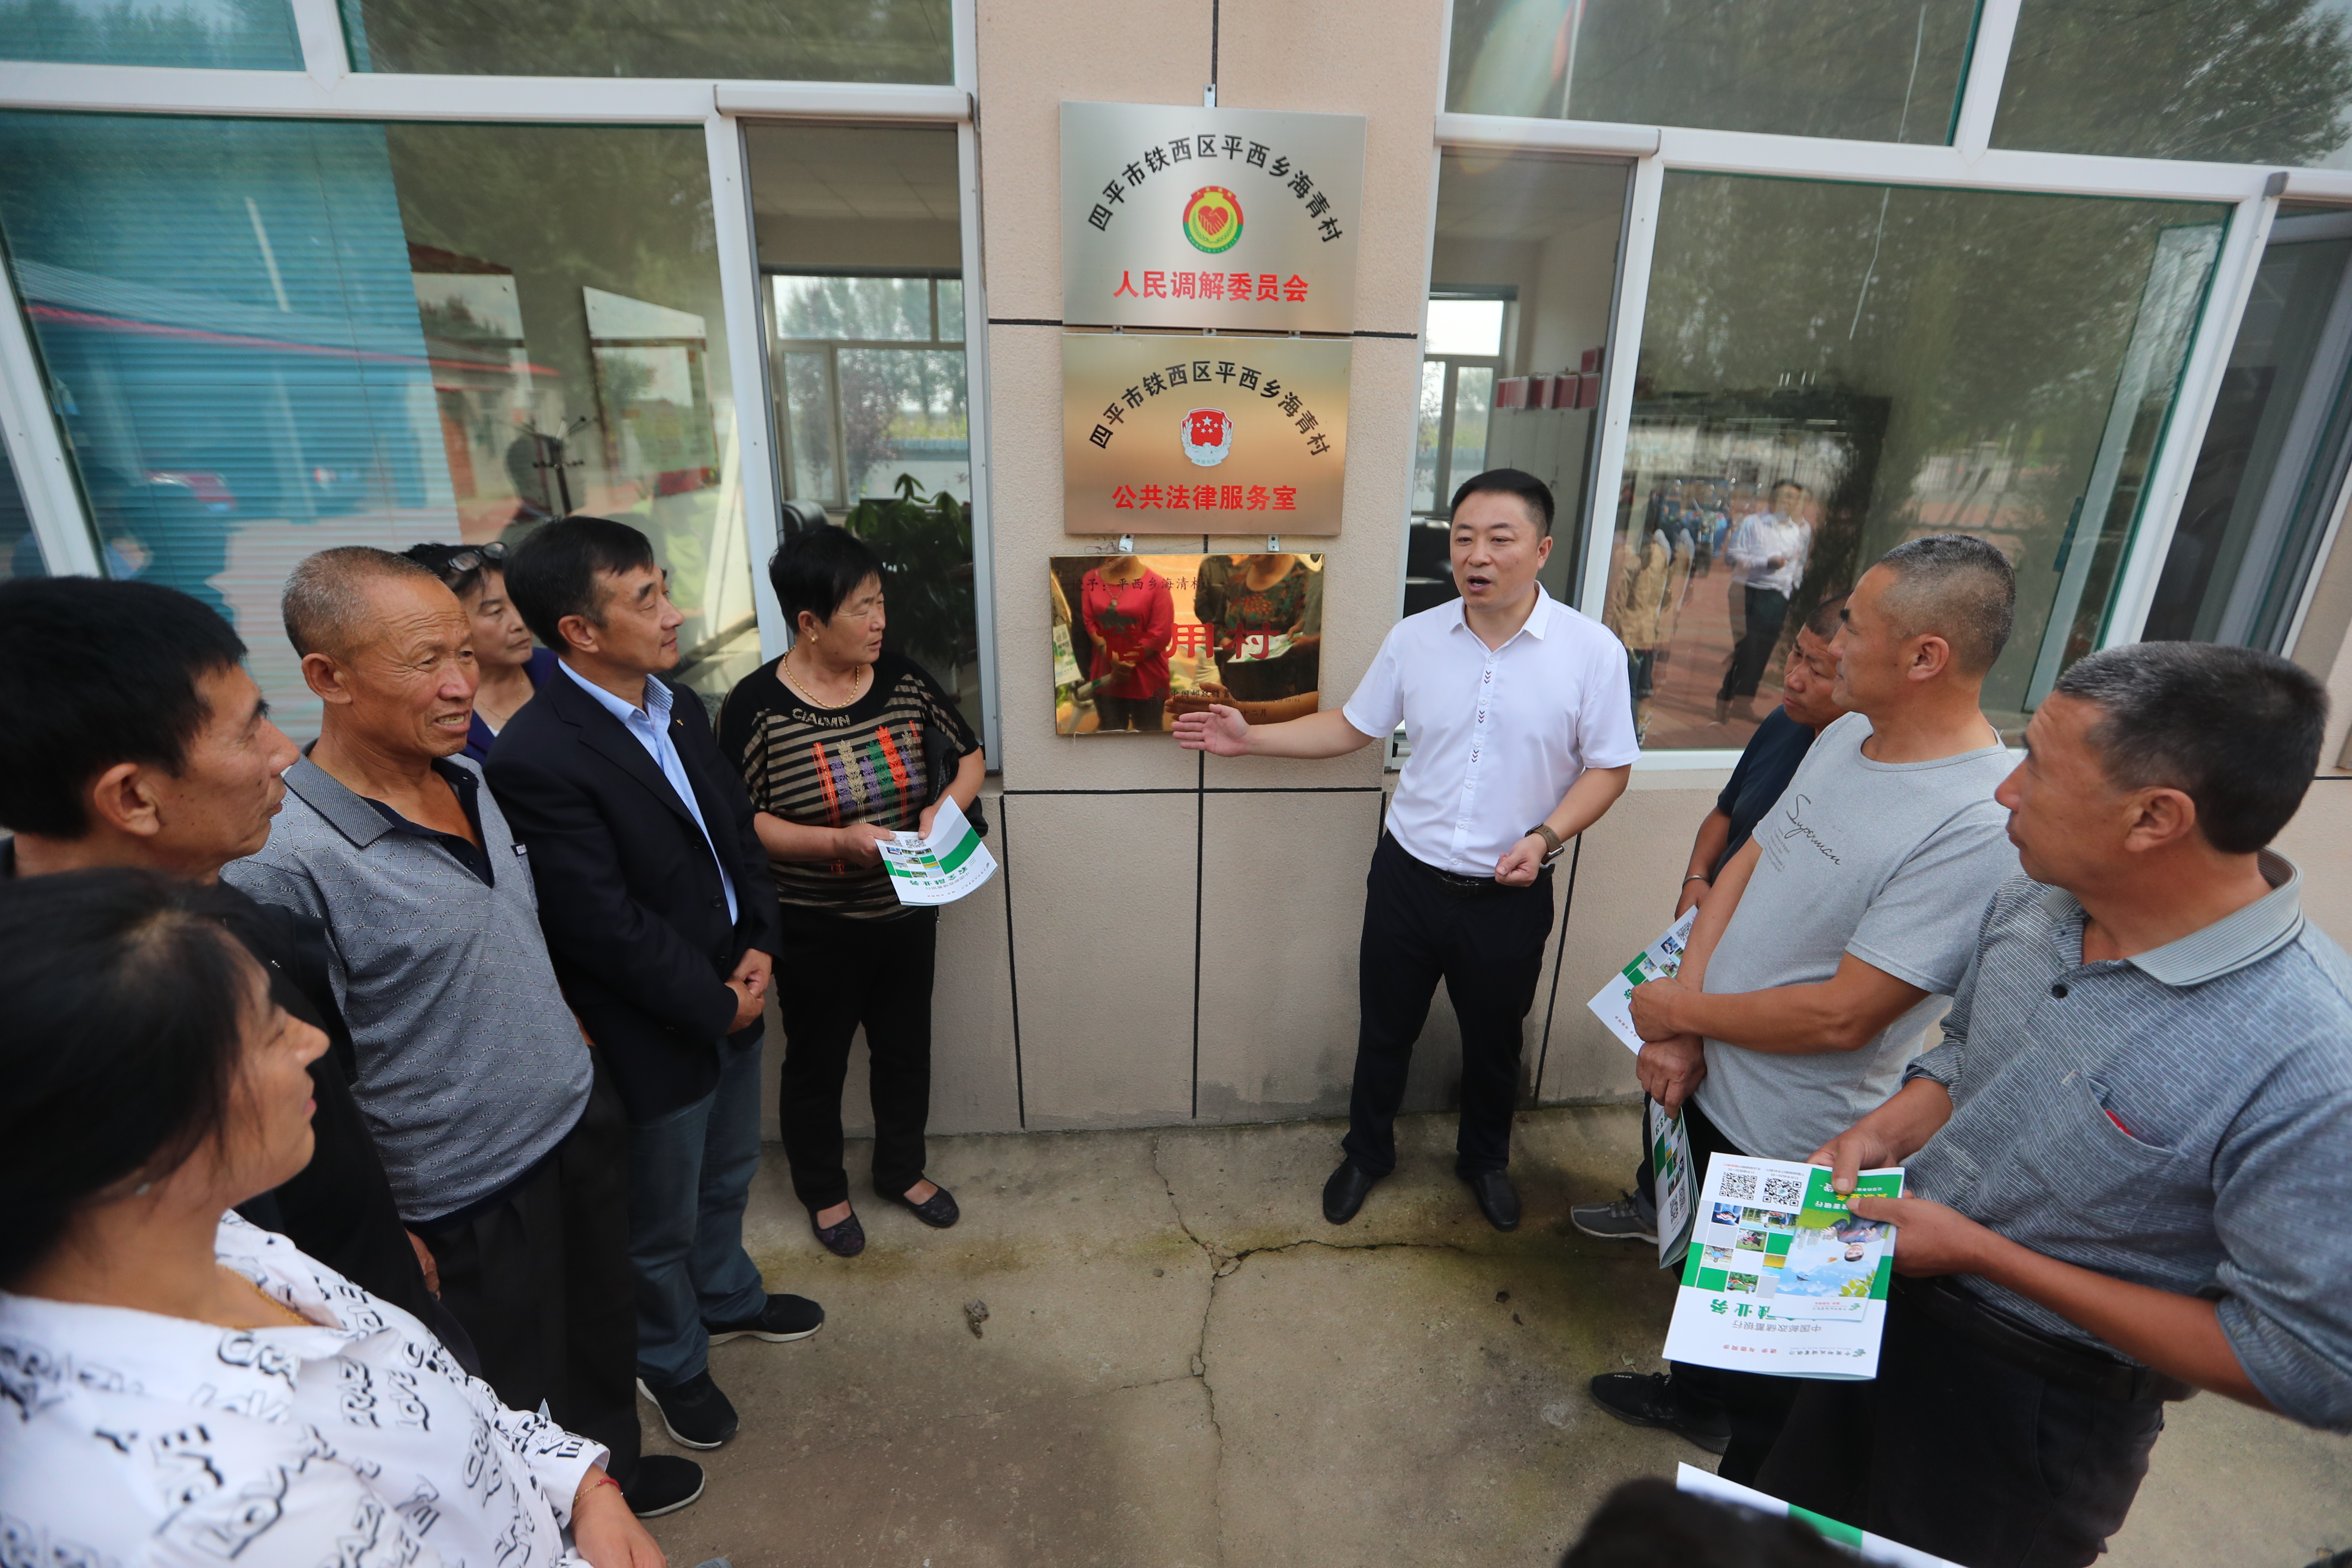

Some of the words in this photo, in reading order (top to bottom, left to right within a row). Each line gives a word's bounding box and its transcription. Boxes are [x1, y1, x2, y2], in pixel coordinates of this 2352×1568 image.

[1088, 134, 1343, 243] 四平市铁西区平西乡海青村
[1113, 270, 1308, 302] 人民调解委员会
[1089, 360, 1330, 456] 四平市铁西区平西乡海青村
[1112, 484, 1297, 510] 公共法律服务室
[1096, 622, 1281, 661] 信用村
[1732, 1320, 1822, 1332] 中国邮政储蓄银行
